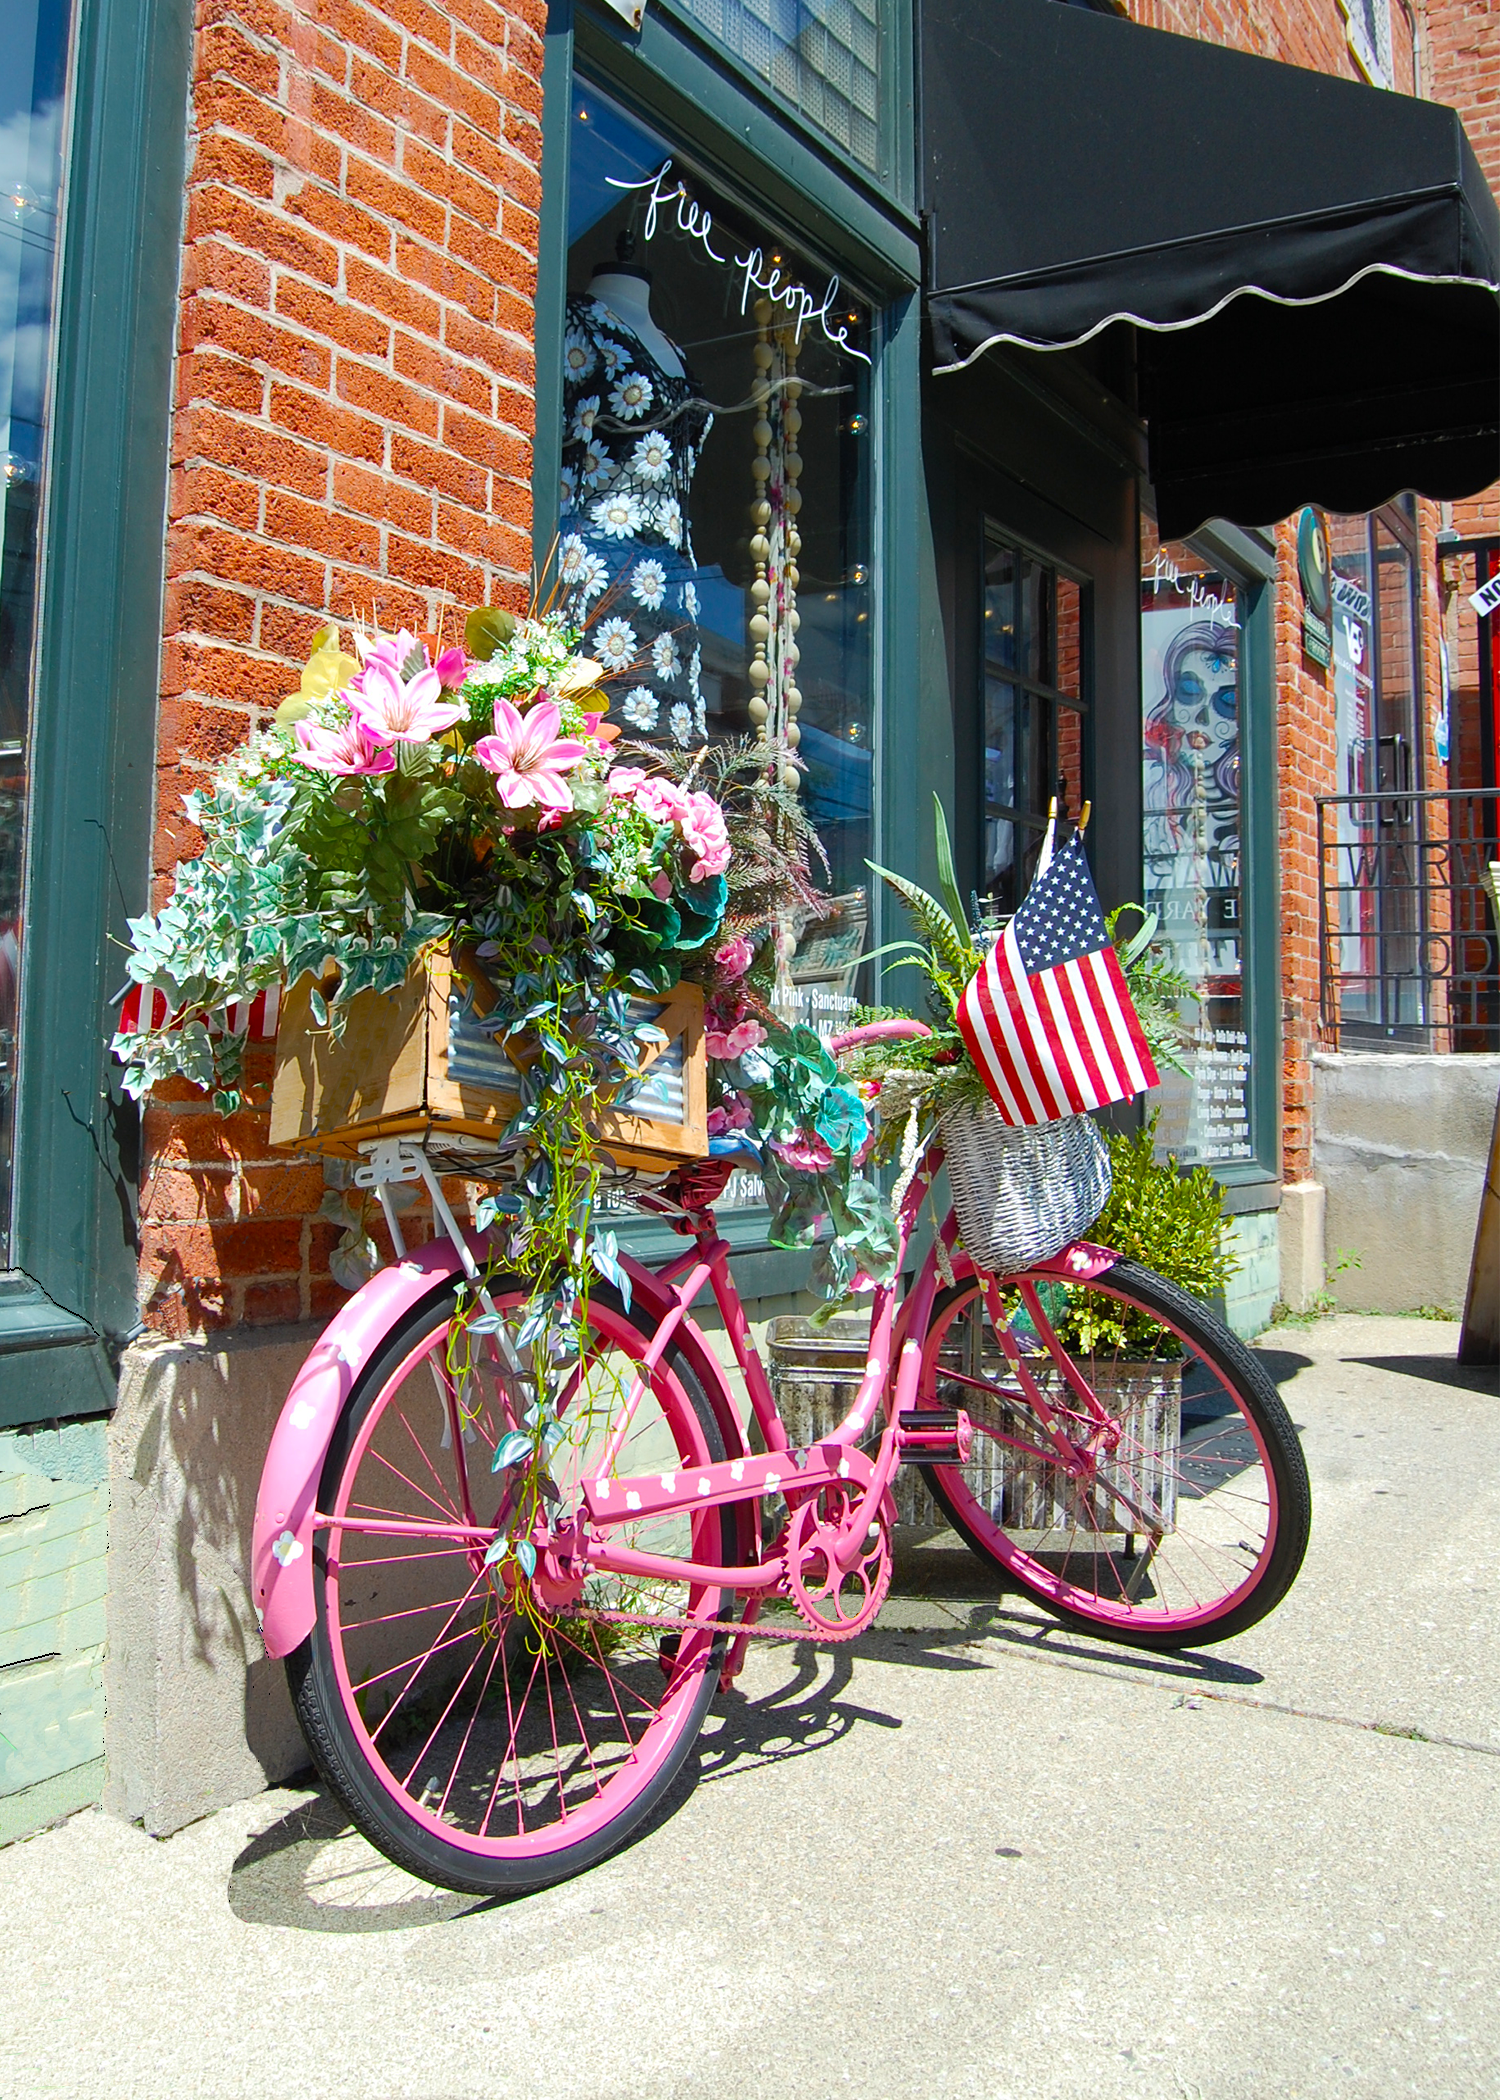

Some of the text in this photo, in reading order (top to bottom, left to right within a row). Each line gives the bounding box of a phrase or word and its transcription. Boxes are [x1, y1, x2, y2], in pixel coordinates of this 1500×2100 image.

[605, 160, 872, 365] free people
[783, 986, 804, 1008] Pink
[740, 1175, 766, 1198] Salv
